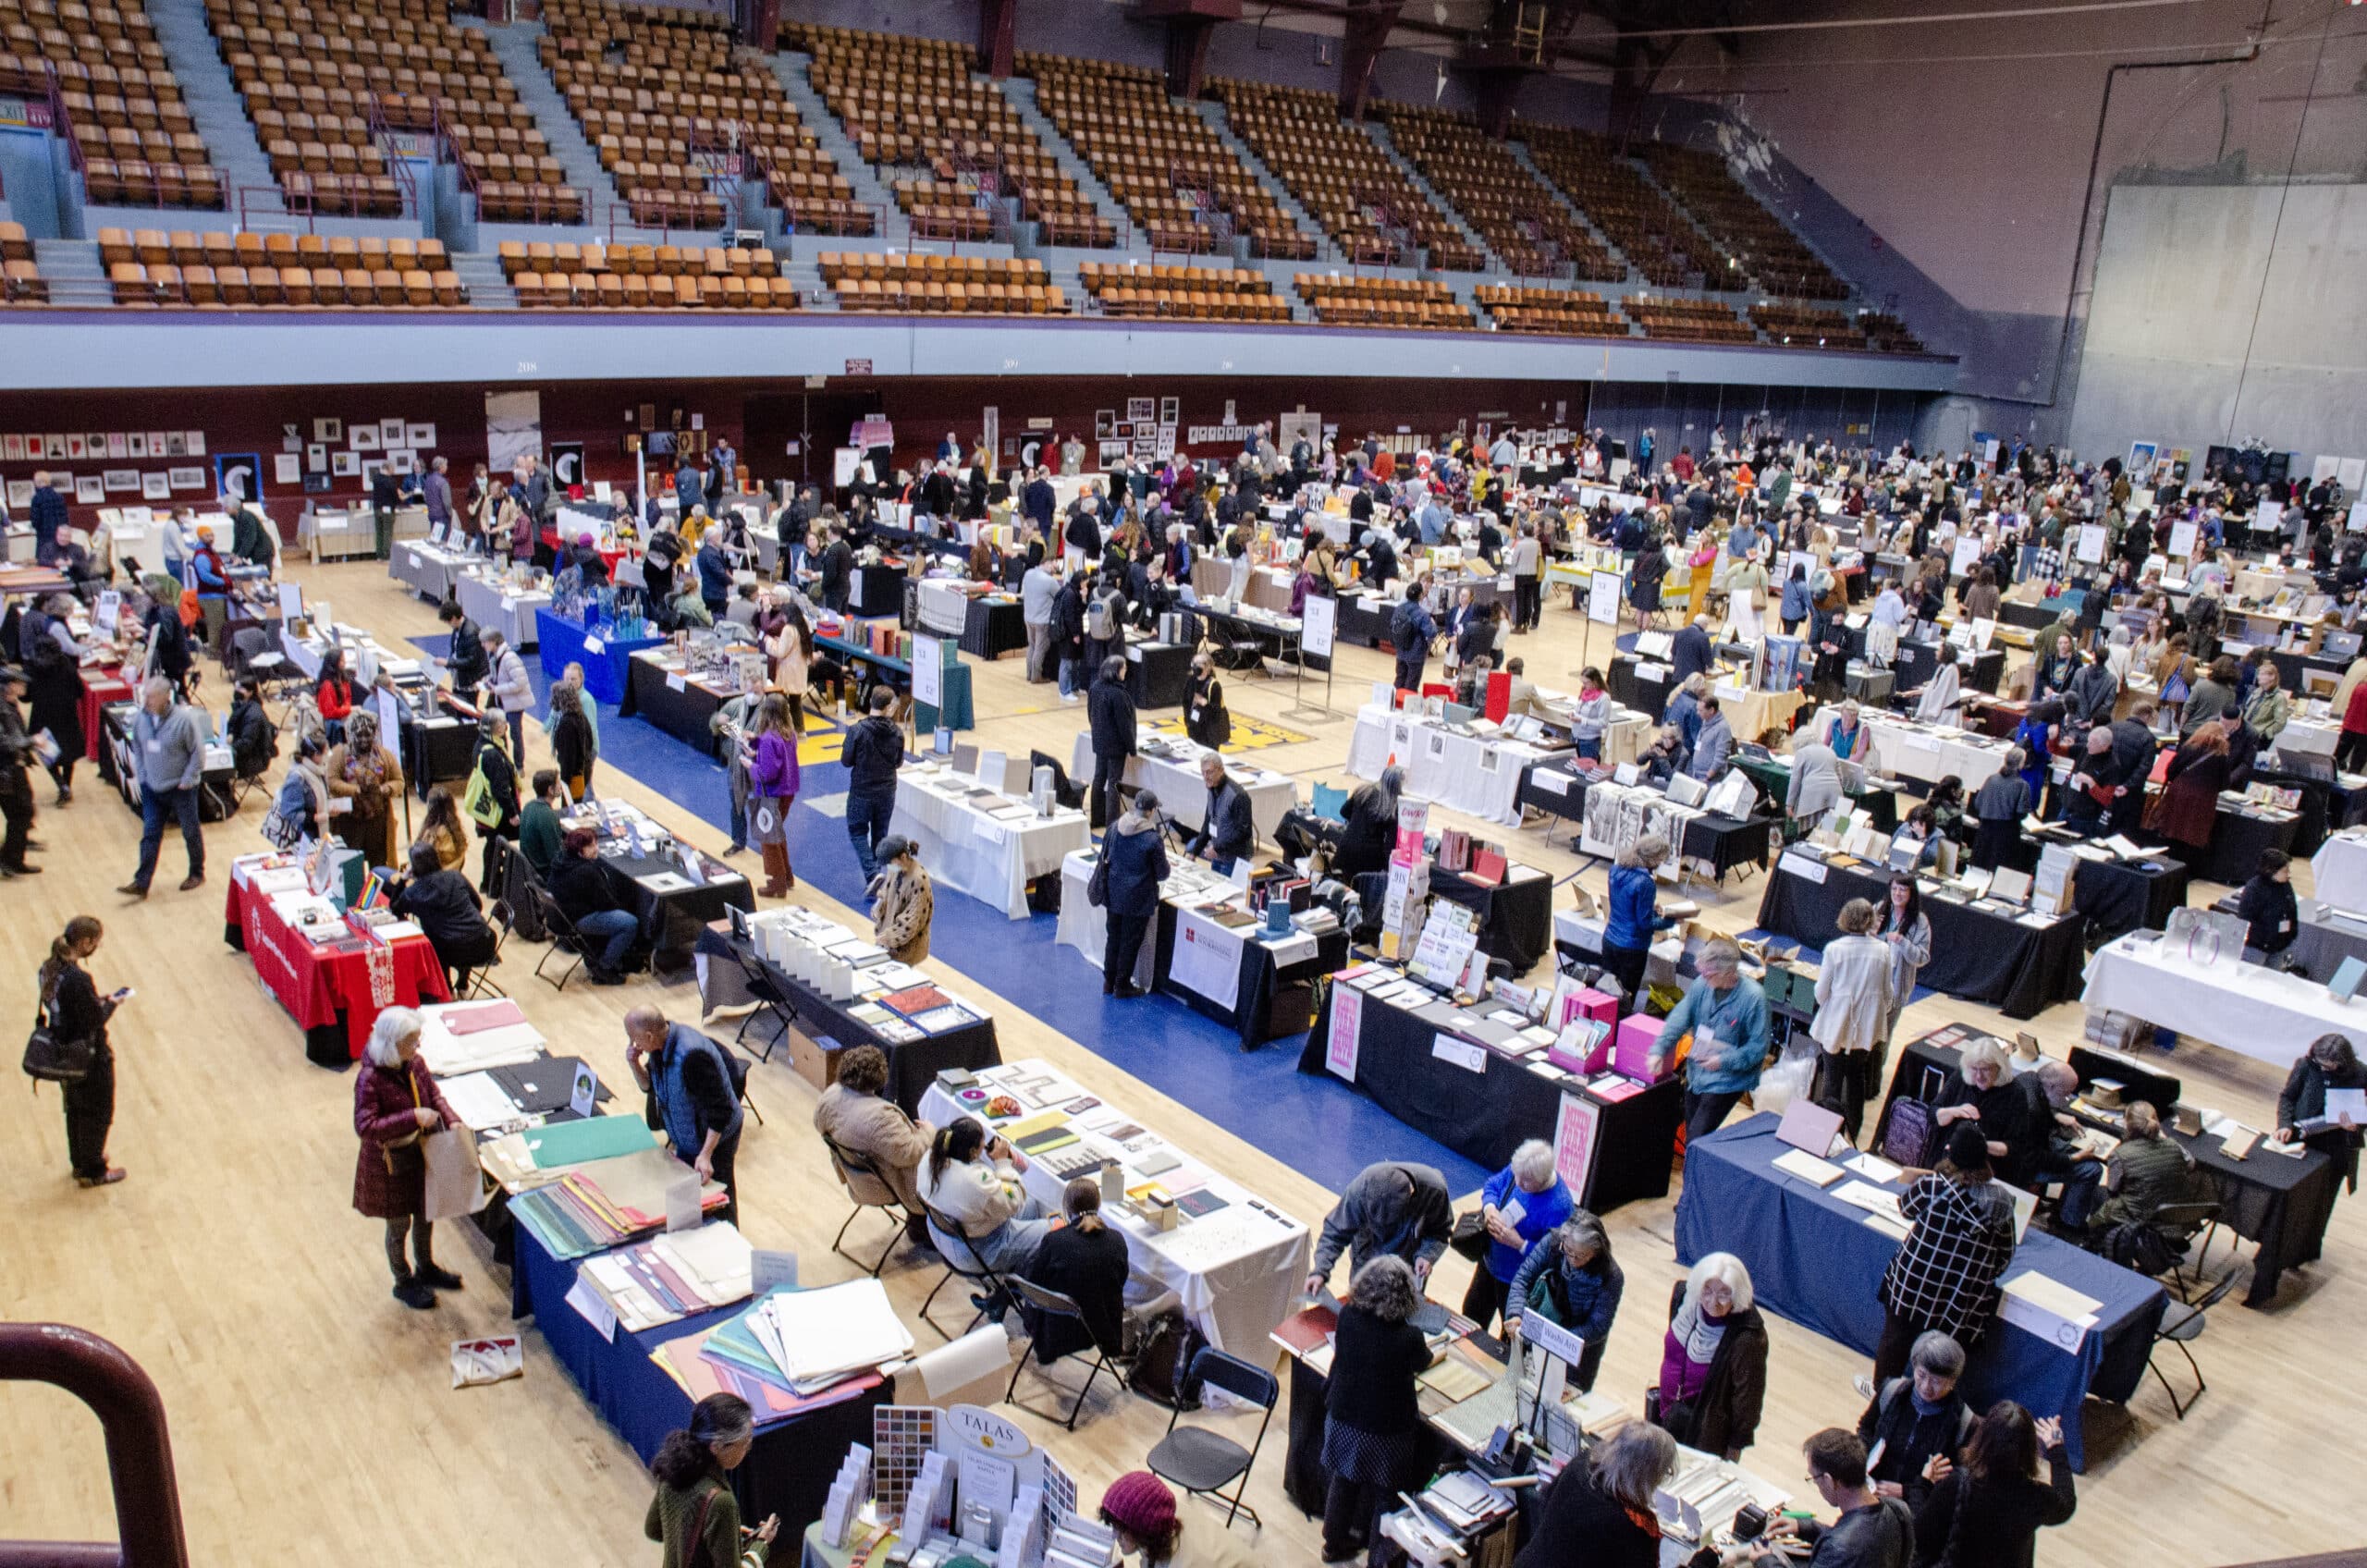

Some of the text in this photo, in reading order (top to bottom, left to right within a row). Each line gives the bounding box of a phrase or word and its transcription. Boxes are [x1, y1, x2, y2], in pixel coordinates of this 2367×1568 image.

[0, 104, 24, 120] XIT
[1544, 1326, 1564, 1344] Washi
[1564, 1338, 1577, 1353] Arts
[962, 1411, 1013, 1441] TALAS
